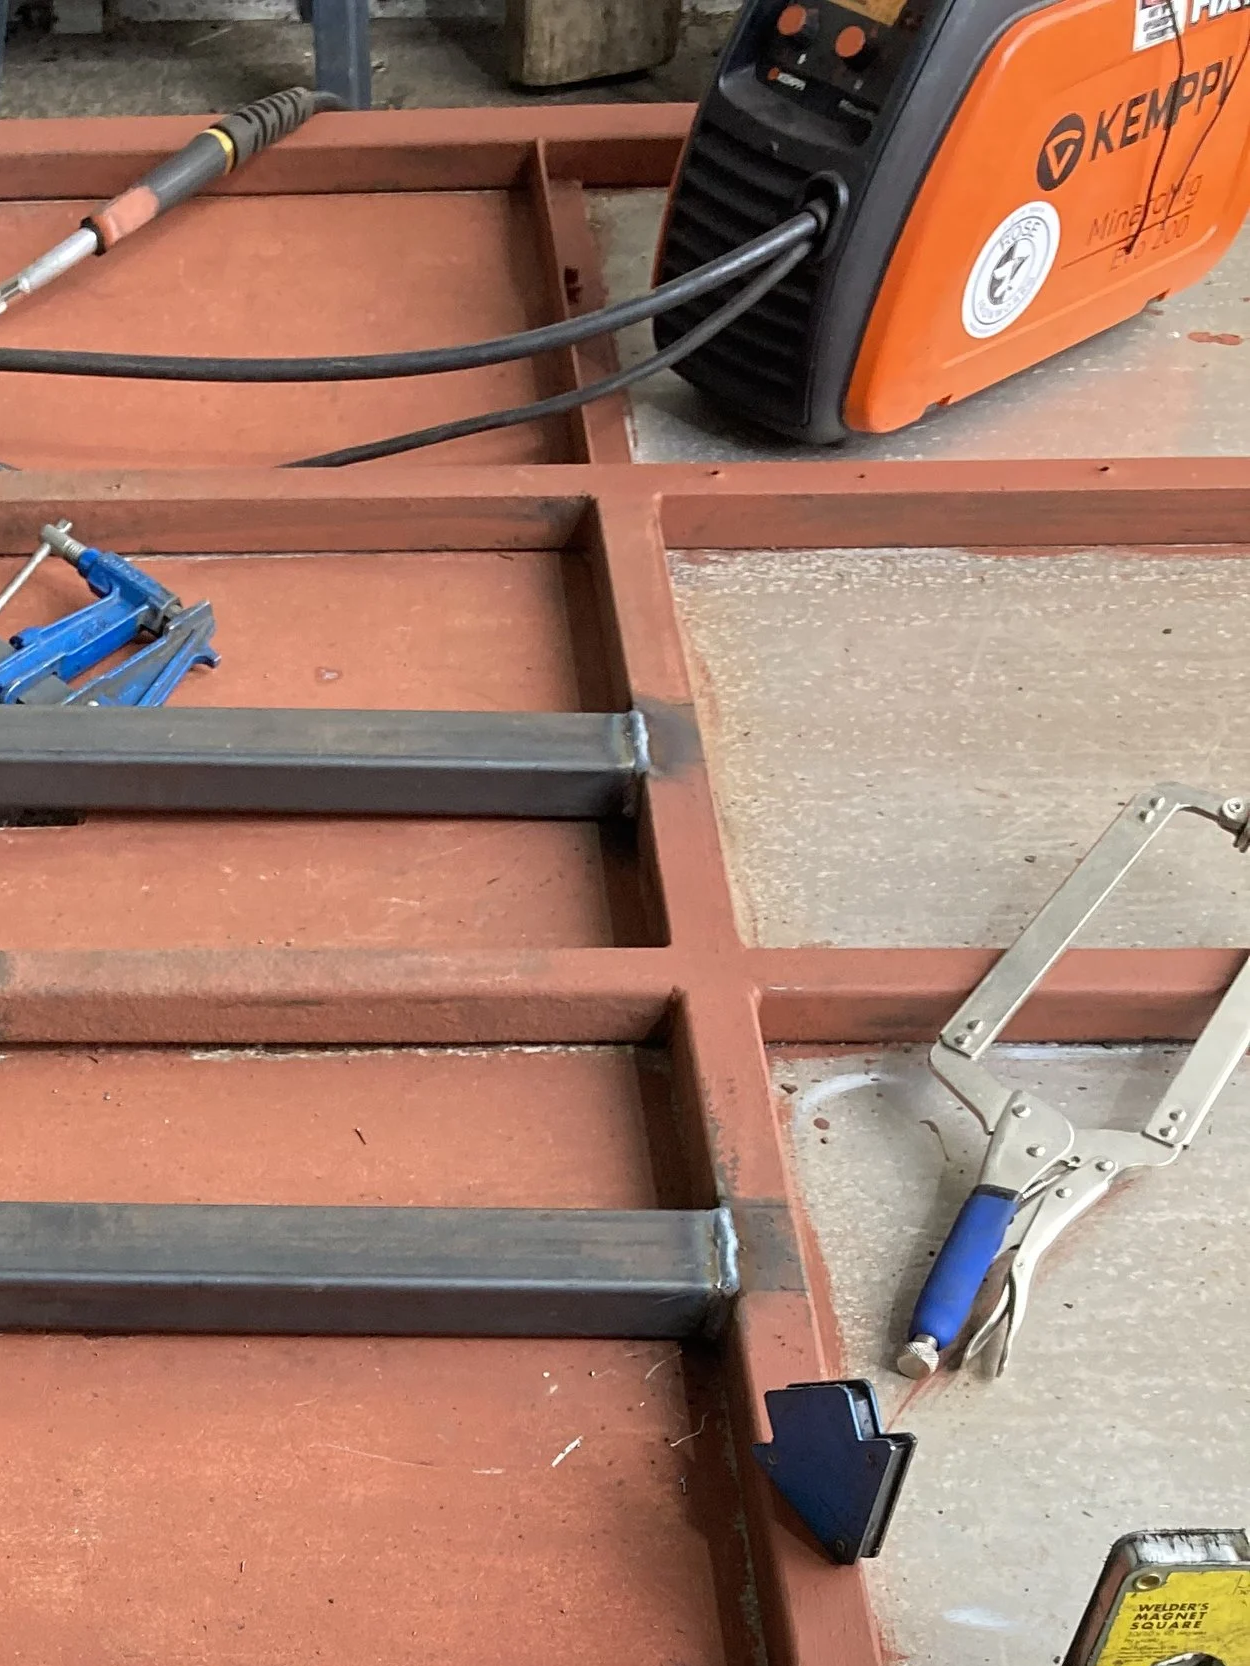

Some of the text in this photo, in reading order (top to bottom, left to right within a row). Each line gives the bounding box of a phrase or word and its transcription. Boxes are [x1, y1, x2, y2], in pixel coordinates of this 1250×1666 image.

[1088, 56, 1233, 162] KEMPPI
[1139, 1603, 1209, 1612] WELDER'S
[1133, 1612, 1207, 1621] MAGNET
[1129, 1620, 1203, 1630] SQUARE
